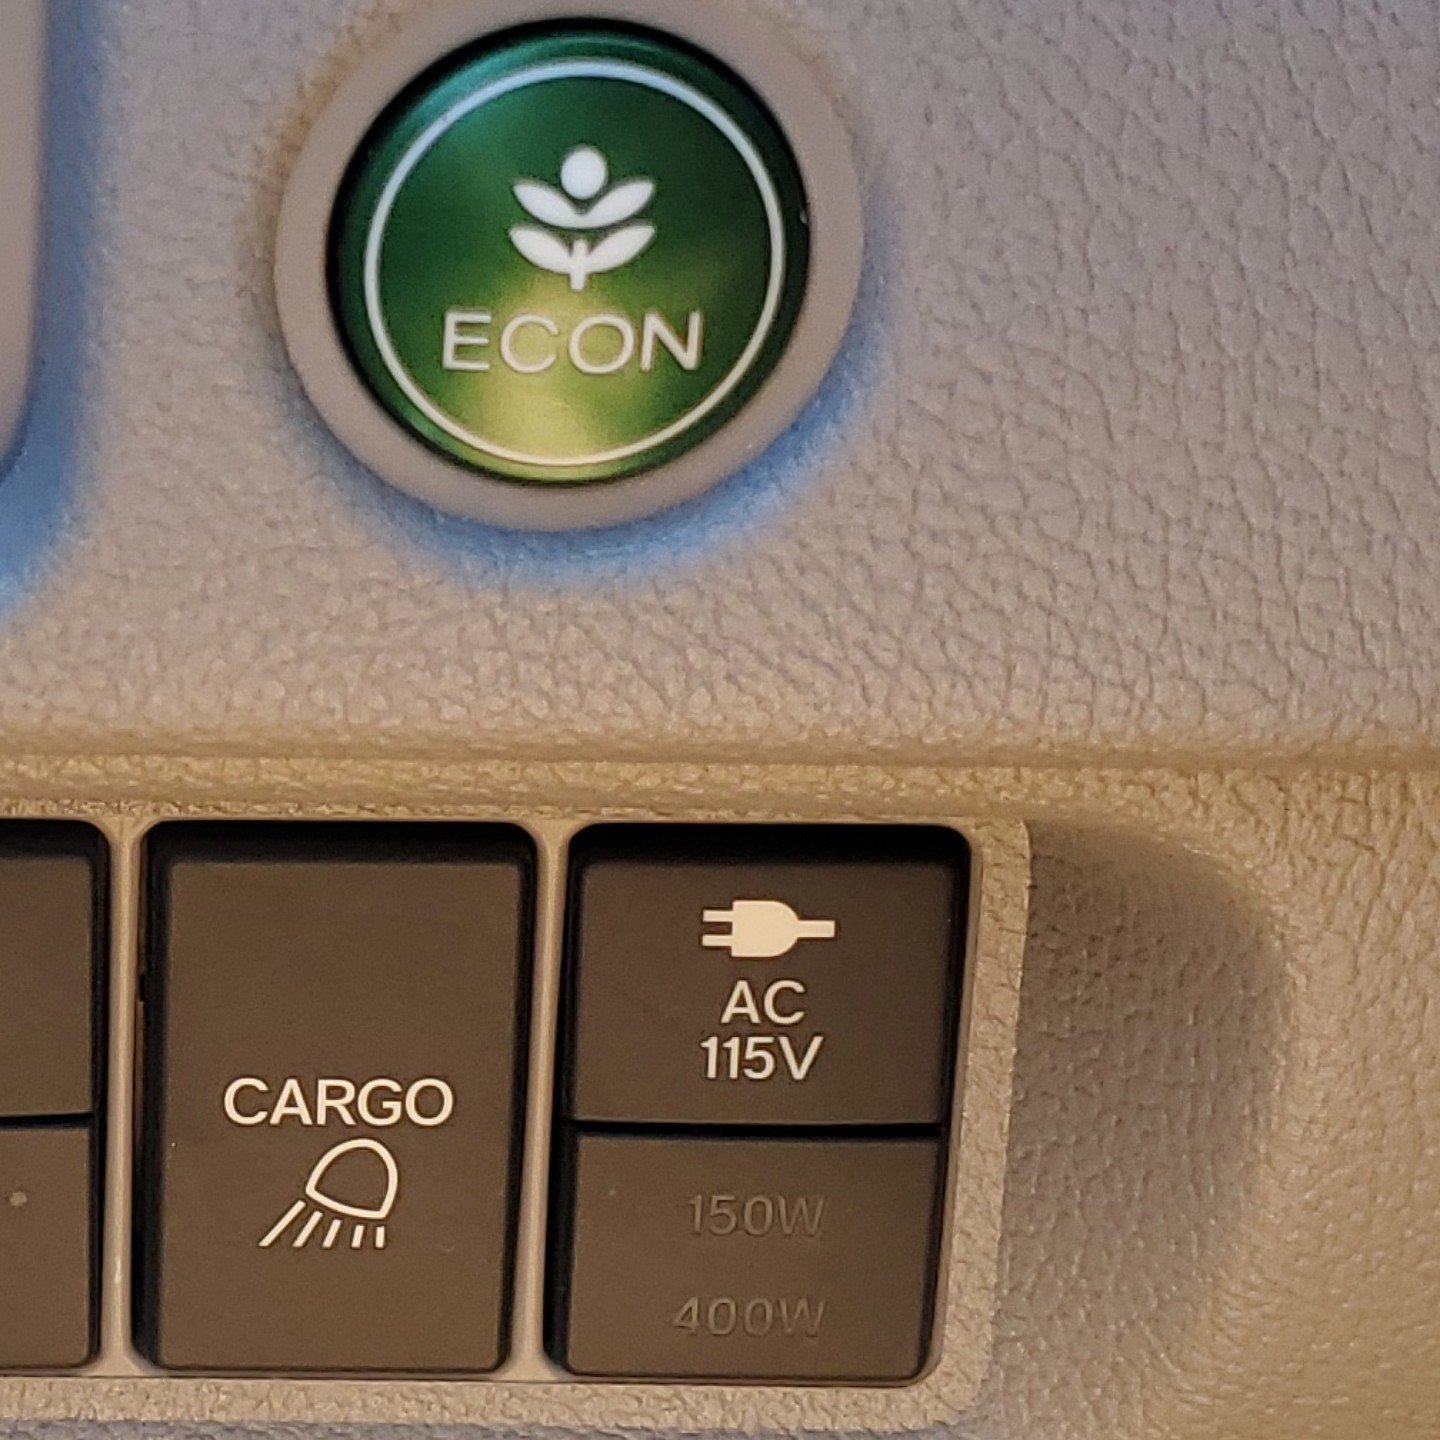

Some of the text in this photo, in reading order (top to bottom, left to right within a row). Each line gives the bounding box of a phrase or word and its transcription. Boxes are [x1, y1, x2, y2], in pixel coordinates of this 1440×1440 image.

[442, 310, 702, 375] ECON
[721, 979, 805, 1025] AC
[700, 1035, 823, 1080] 115V
[223, 1077, 454, 1128] CARGO
[687, 1194, 824, 1237] 150W
[673, 1296, 826, 1337] 400W
